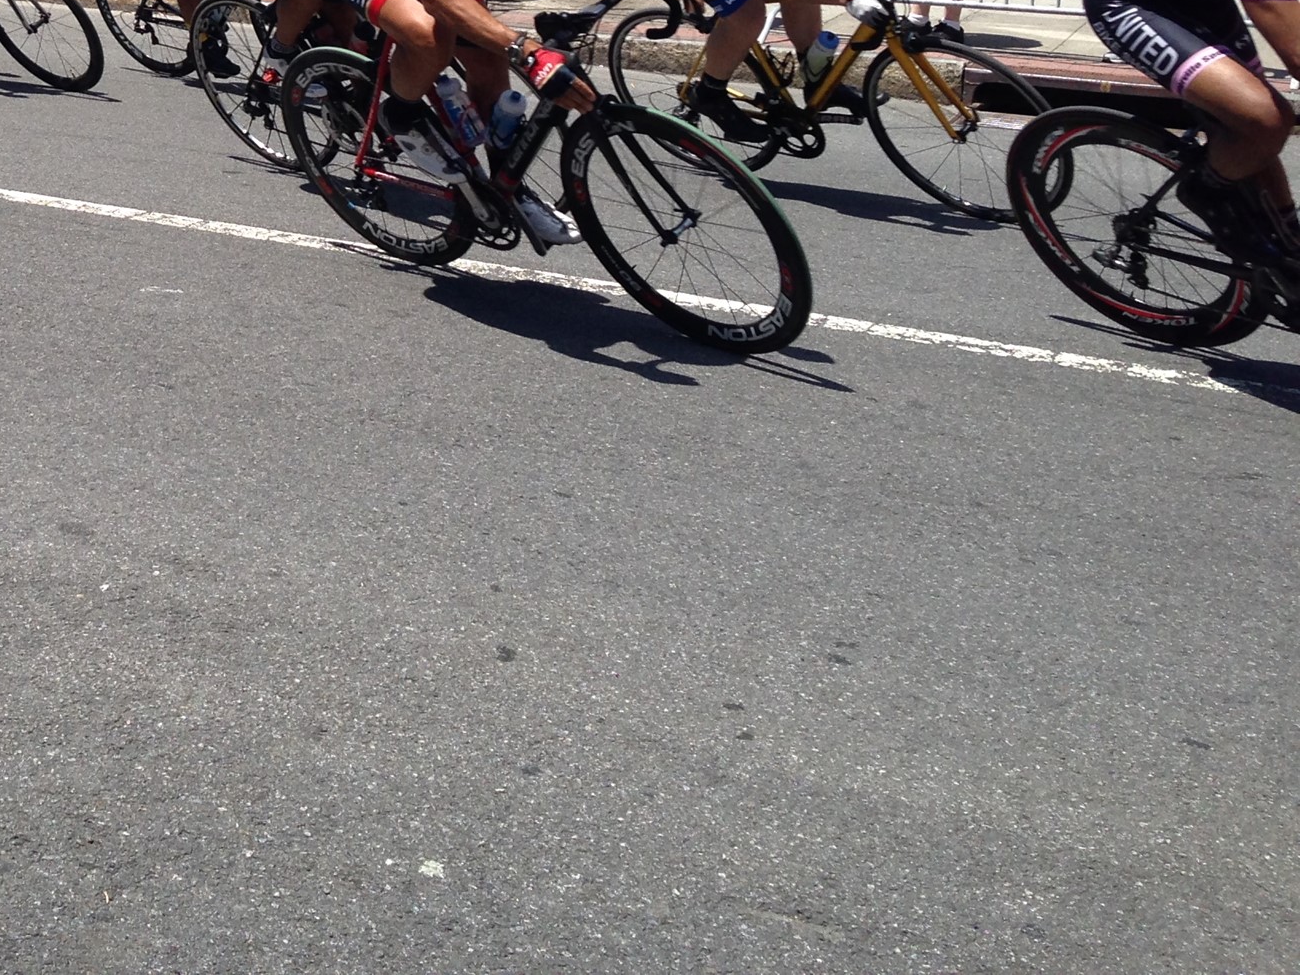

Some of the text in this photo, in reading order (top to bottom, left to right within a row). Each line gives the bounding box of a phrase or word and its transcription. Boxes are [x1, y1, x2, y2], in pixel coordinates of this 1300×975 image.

[1101, 1, 1180, 76] UNITED
[363, 220, 449, 254] EASTON
[707, 291, 793, 342] EASTON
[1121, 310, 1196, 326] TOKEN
